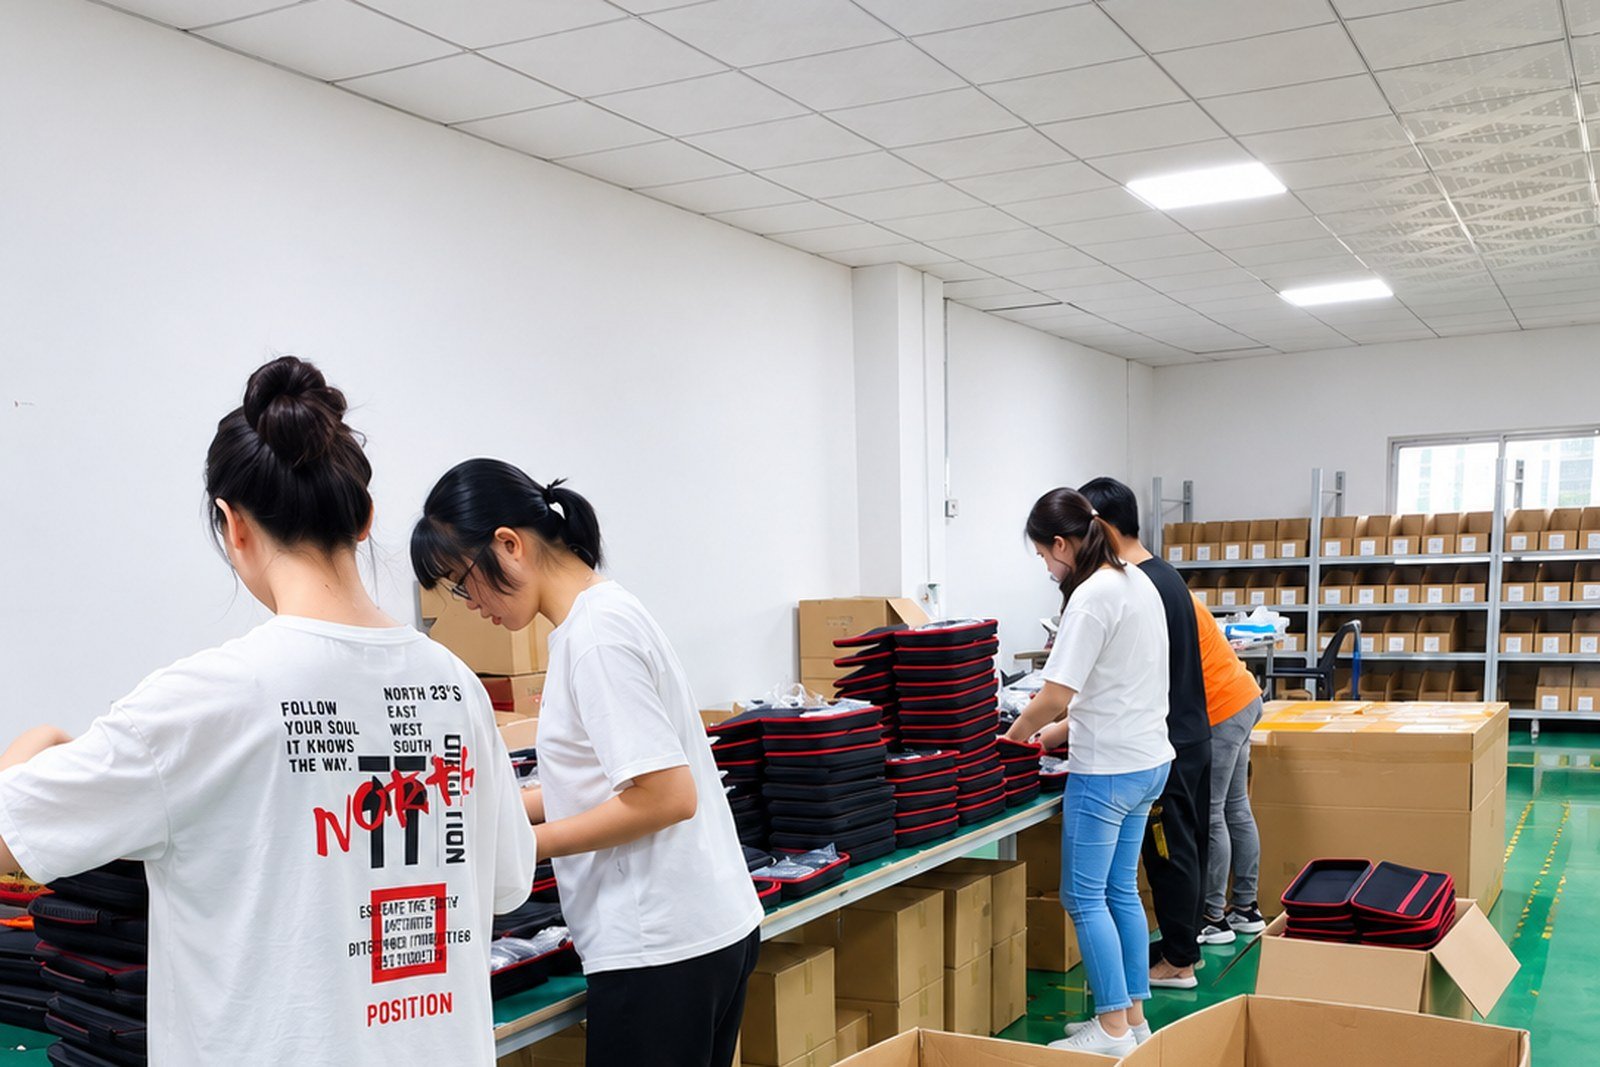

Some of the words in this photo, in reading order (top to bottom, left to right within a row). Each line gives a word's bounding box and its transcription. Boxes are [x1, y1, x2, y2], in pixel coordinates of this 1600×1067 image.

[384, 686, 426, 701] NORTH
[281, 700, 338, 716] FOLLOW
[387, 706, 417, 718] EAST
[284, 720, 322, 735] YOUR
[328, 720, 360, 735] SOUL
[390, 723, 422, 736] WEST
[287, 740, 300, 754] IT
[306, 740, 354, 754] KNOWS
[394, 740, 432, 753] SOUTH
[290, 758, 316, 772] THE
[324, 758, 352, 772] WAY.
[367, 992, 453, 1027] POSITION
